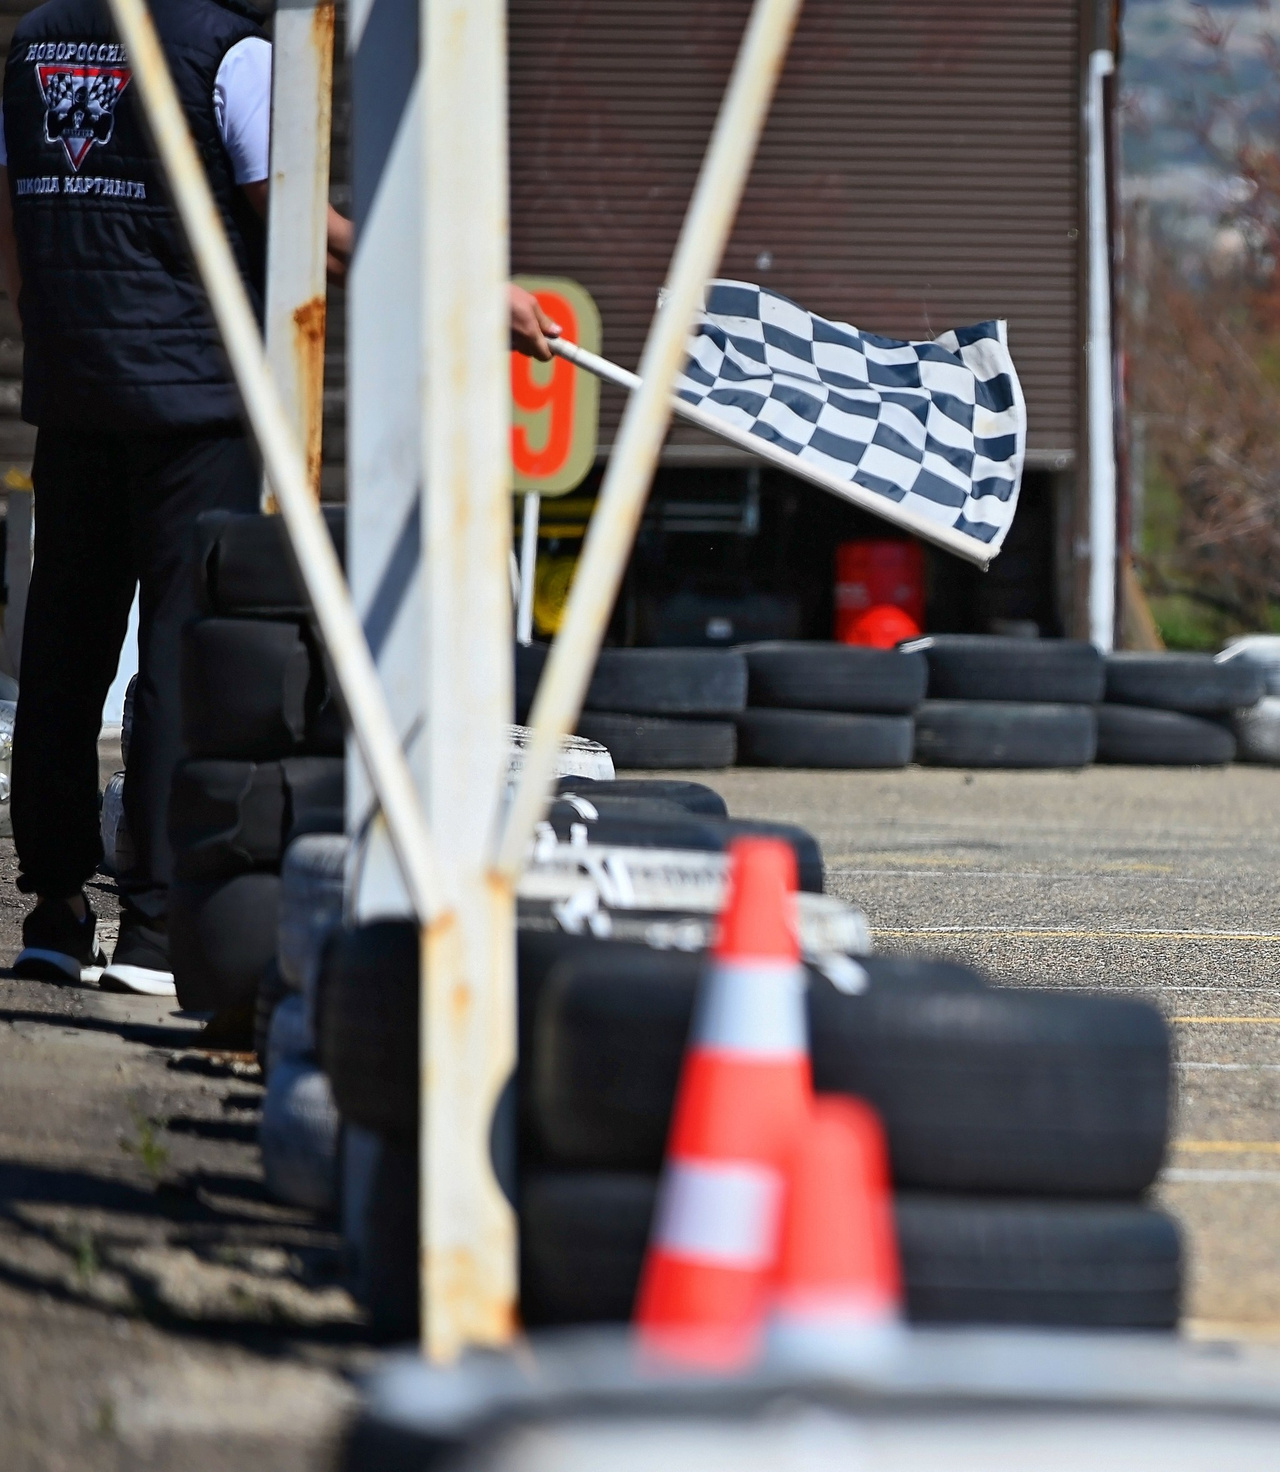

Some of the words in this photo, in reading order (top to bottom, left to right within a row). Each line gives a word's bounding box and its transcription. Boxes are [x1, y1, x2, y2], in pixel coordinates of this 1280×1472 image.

[17, 177, 60, 195] ШКОЛА
[63, 176, 146, 199] КАРТИНГА
[510, 290, 579, 480] 9
